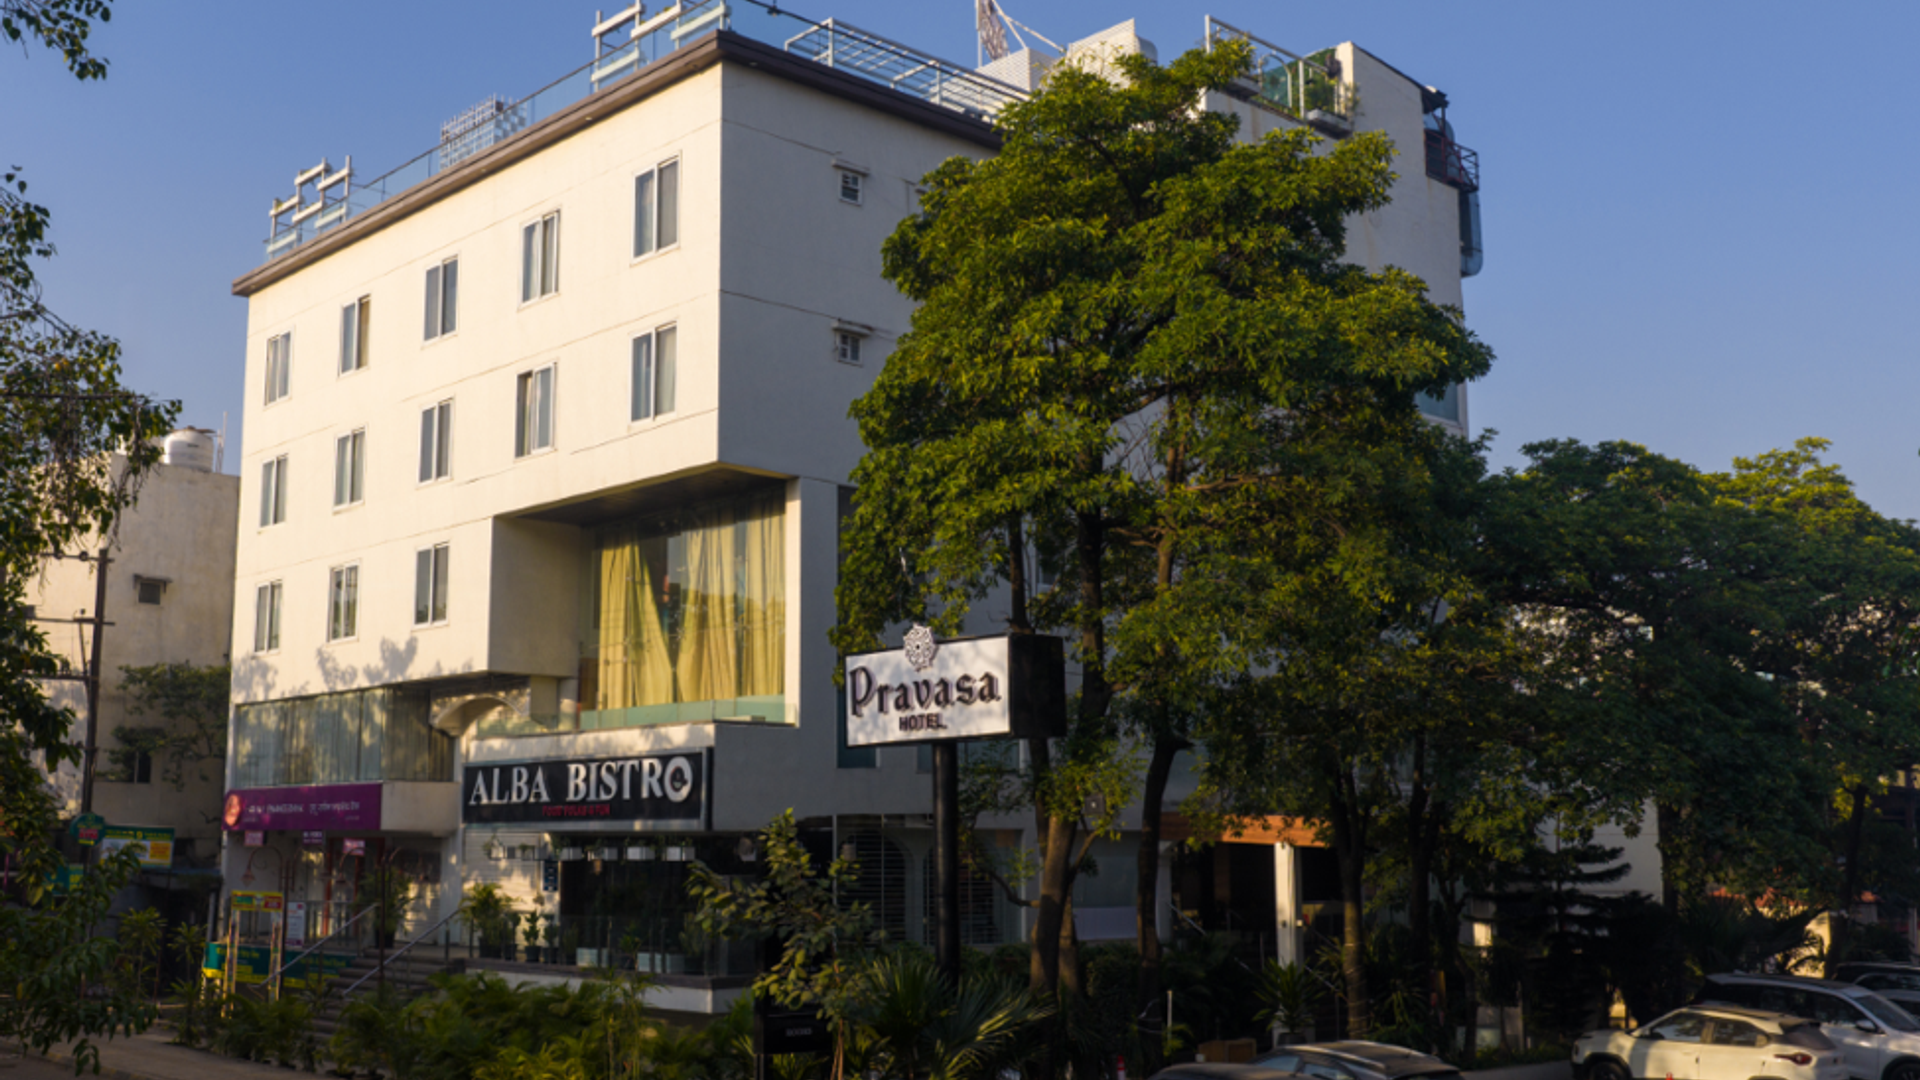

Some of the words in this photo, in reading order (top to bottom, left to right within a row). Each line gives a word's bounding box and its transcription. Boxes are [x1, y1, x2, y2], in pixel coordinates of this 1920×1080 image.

[849, 666, 1002, 718] Pravasa
[899, 713, 947, 731] HOTEL
[469, 765, 550, 805] ALBA
[566, 756, 693, 802] BISTRO
